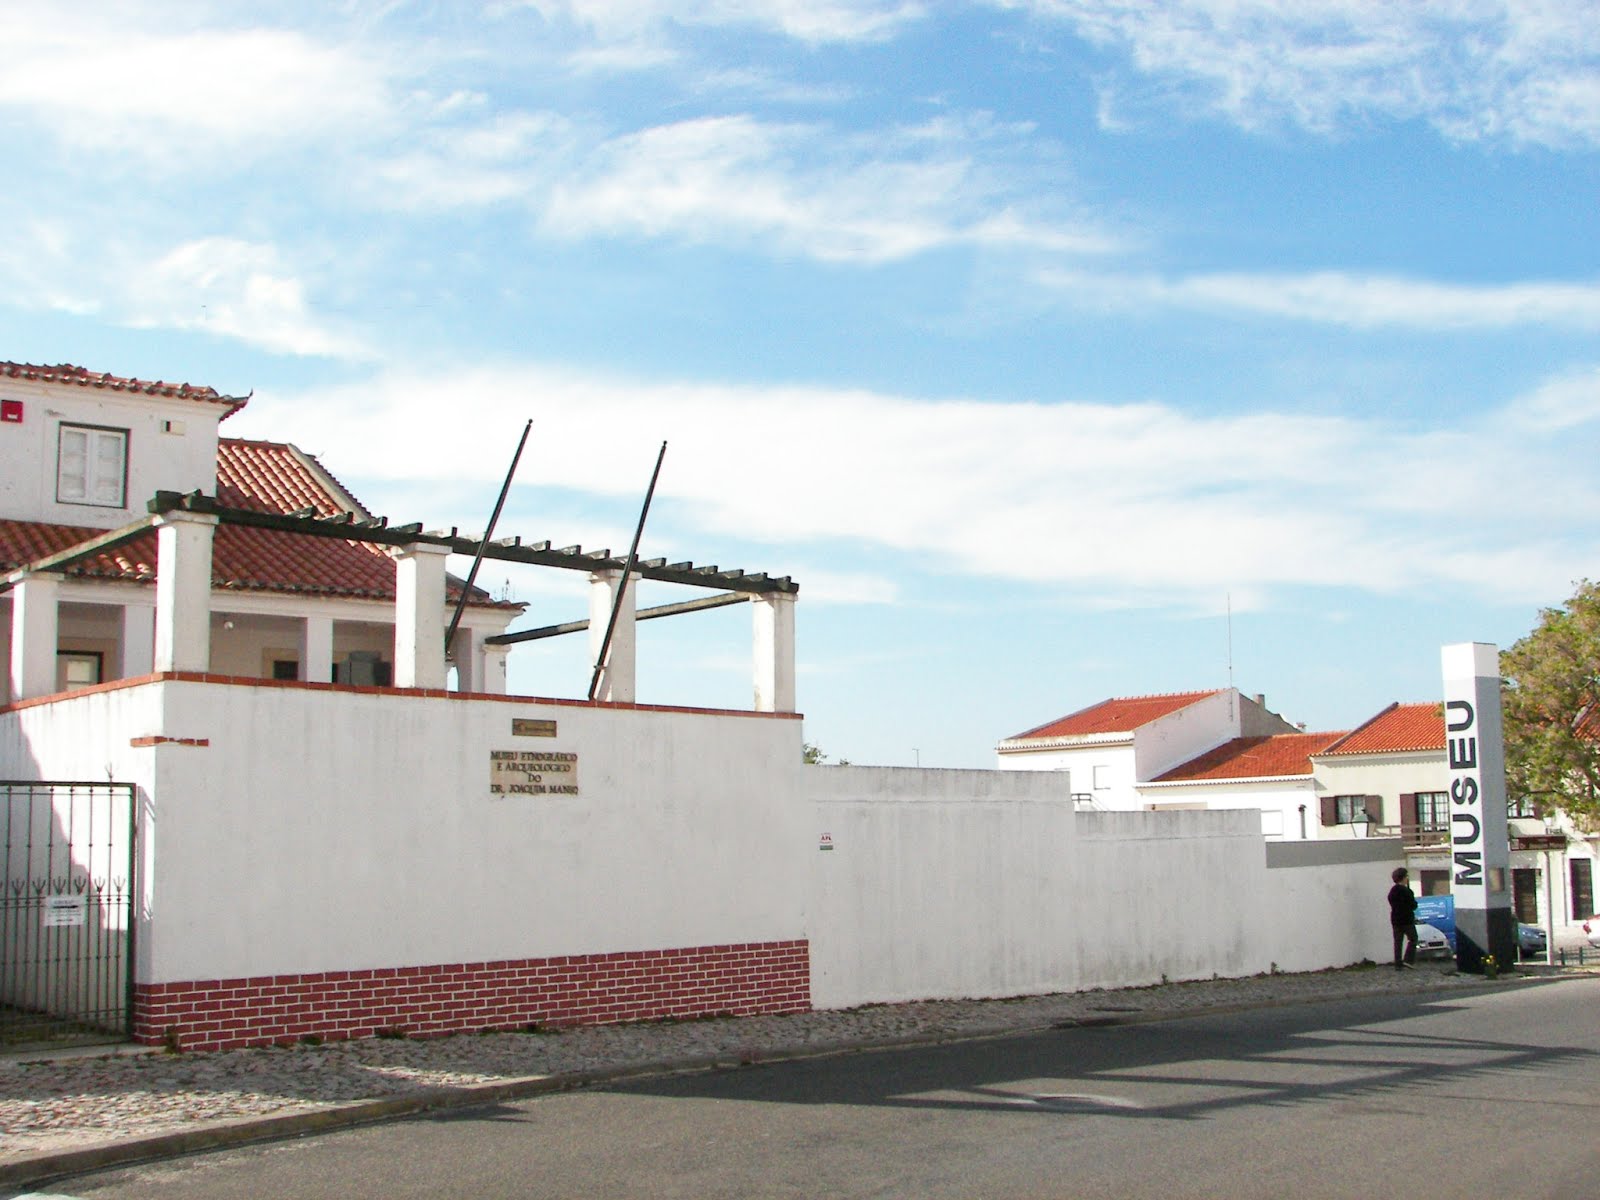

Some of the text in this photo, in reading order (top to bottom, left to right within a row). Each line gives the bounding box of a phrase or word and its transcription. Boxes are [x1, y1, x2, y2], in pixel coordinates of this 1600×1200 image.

[490, 751, 518, 760] MUSEU
[497, 763, 503, 771] E
[528, 774, 542, 783] DO
[509, 785, 547, 795] JOAQUIM
[1447, 701, 1482, 885] MUSEU
